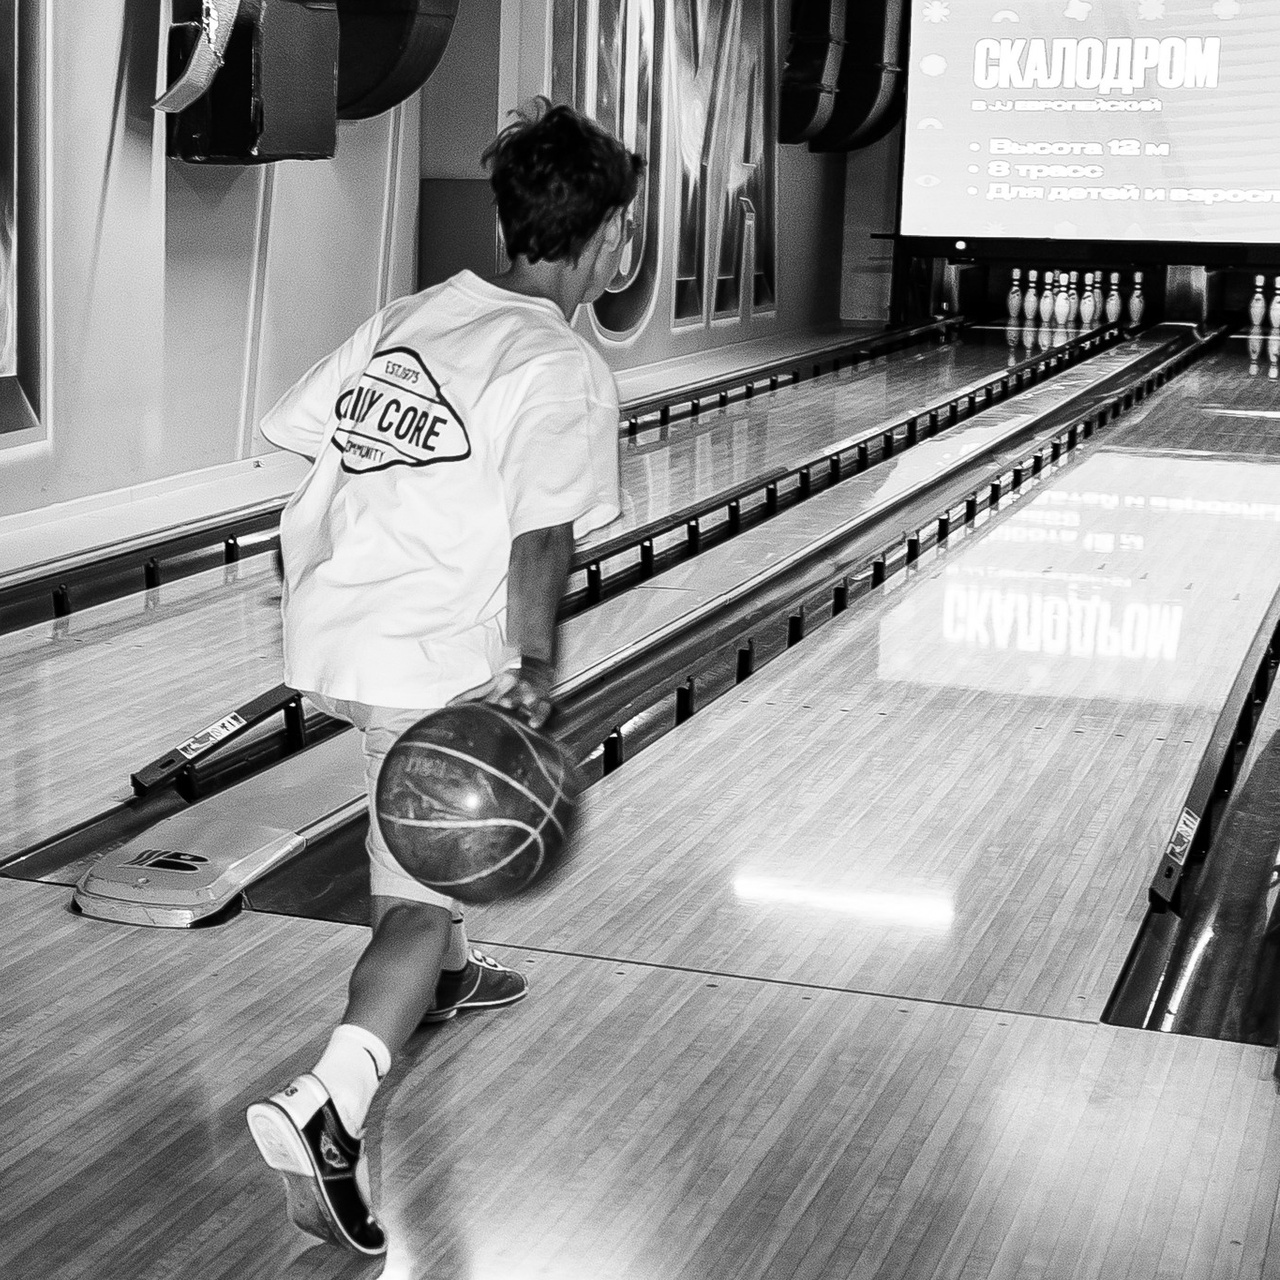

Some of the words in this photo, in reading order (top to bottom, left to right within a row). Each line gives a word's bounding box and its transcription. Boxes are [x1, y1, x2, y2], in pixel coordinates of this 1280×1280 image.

[973, 36, 1221, 95] СКАЛОДРОМ
[1014, 97, 1162, 113] ЕВРОПЕЙСКИЙ
[989, 137, 1104, 156] Высота
[1106, 138, 1141, 156] 12
[1144, 142, 1170, 156] м
[987, 160, 1011, 178] 8
[1014, 164, 1105, 180] трасс
[986, 182, 1045, 201] Для
[1047, 183, 1141, 202] детей
[1144, 187, 1166, 201] и
[377, 398, 448, 452] CORE
